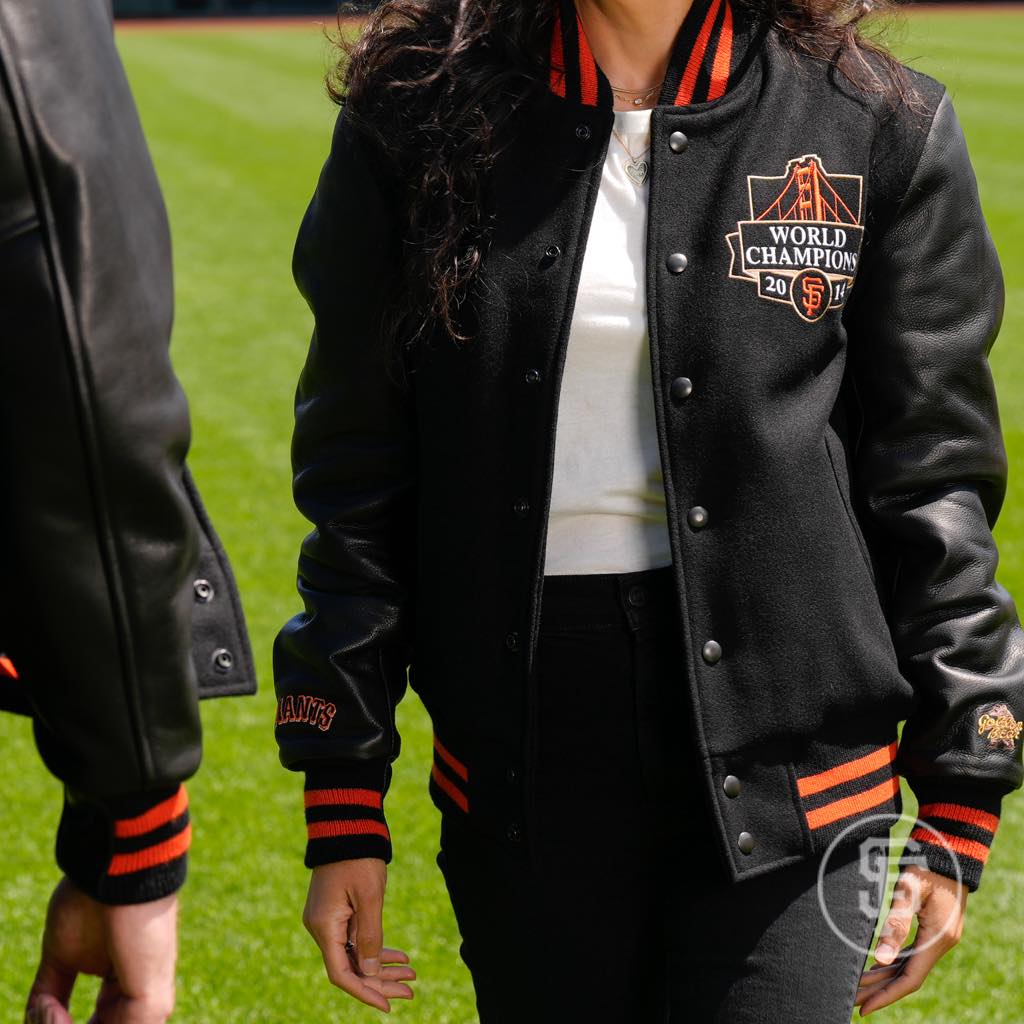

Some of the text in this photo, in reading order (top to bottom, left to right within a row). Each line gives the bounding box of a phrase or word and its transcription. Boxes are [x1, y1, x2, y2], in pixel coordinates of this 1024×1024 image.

[769, 225, 847, 248] WORLD
[745, 246, 858, 272] CHAMPIONS
[765, 275, 787, 295] 20
[802, 276, 825, 316] SF
[276, 694, 337, 732] IANTS
